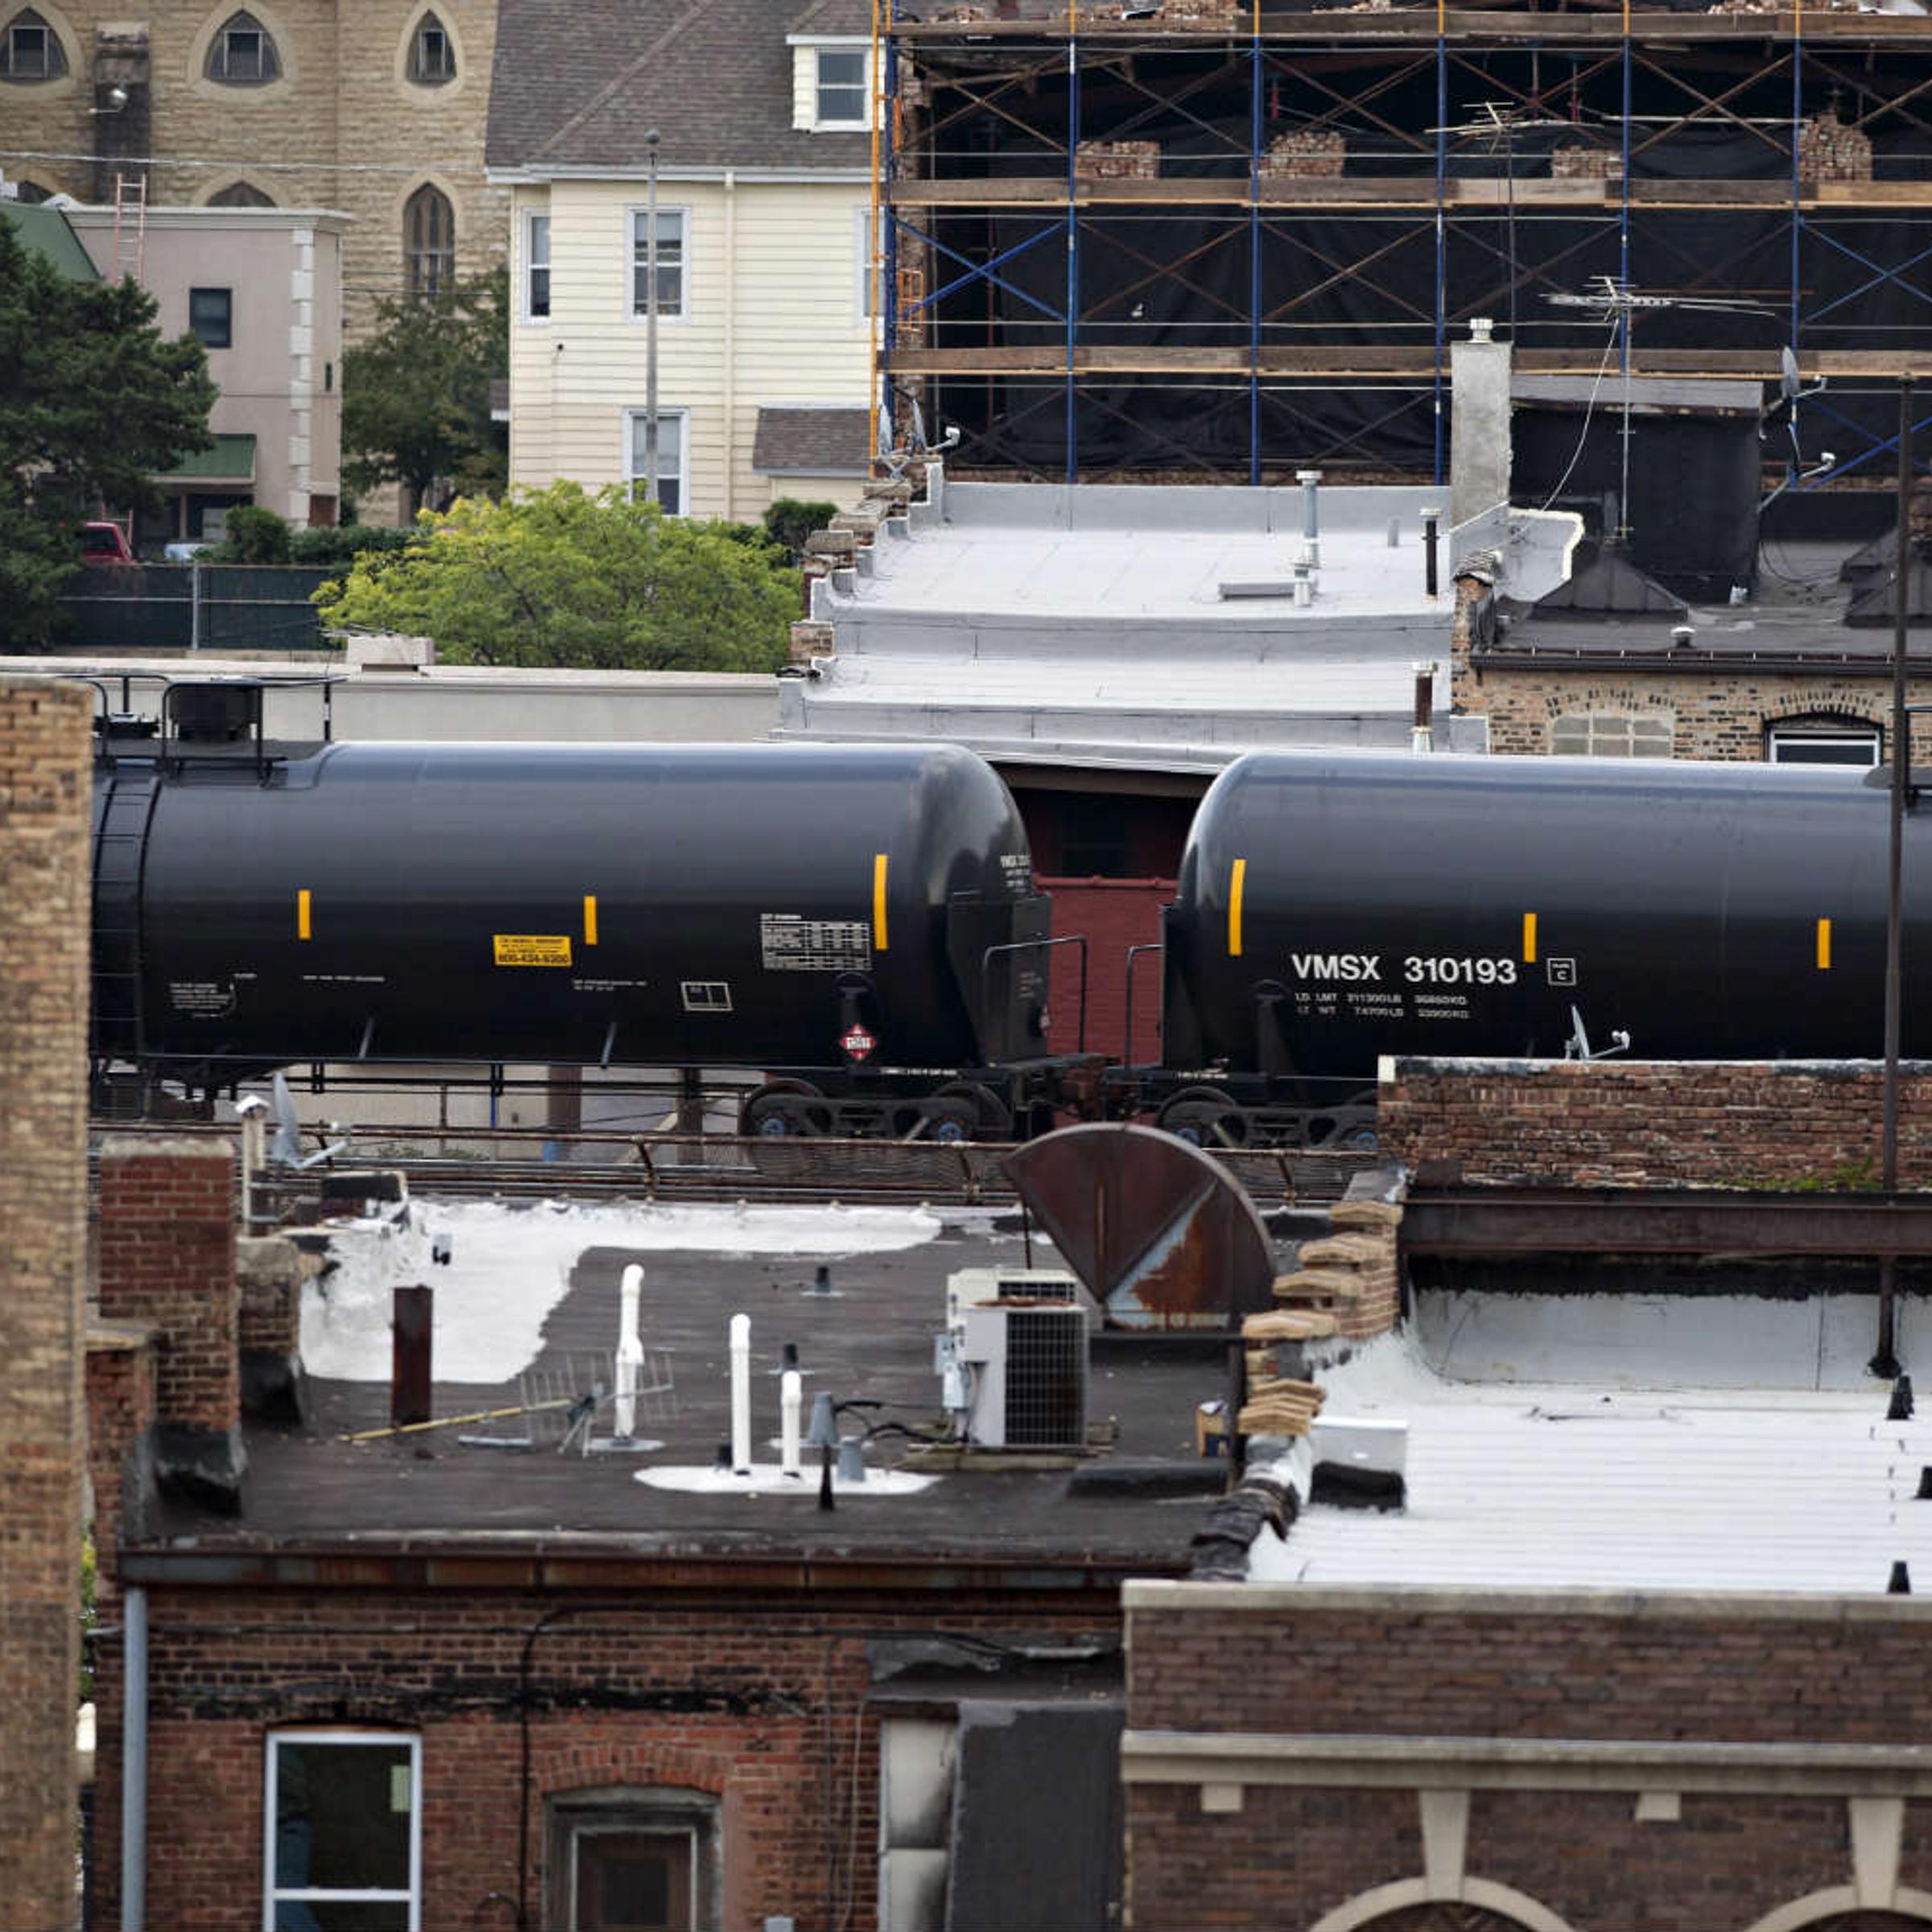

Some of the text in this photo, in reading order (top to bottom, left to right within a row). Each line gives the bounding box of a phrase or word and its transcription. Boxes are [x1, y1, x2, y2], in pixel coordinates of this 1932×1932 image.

[1291, 954, 1517, 985] VMSX 310193
[1557, 970, 1567, 980] C
